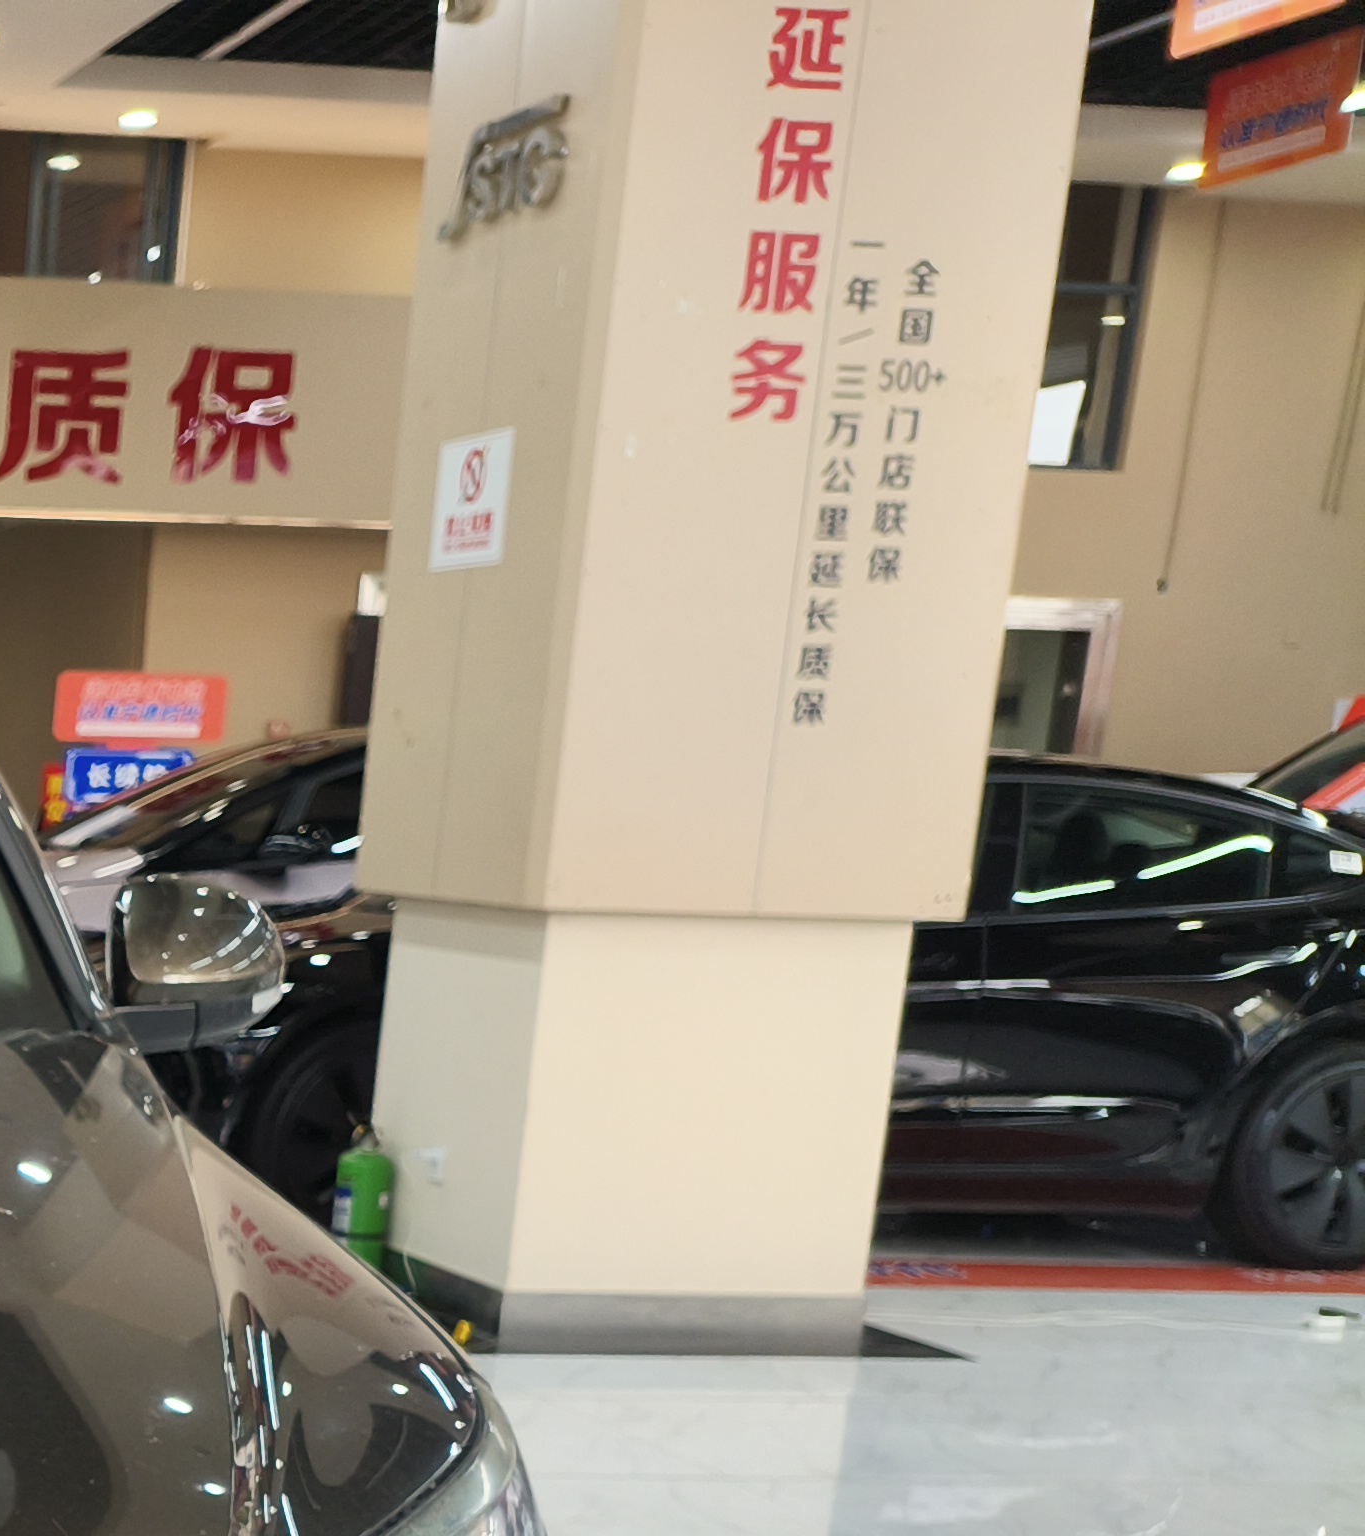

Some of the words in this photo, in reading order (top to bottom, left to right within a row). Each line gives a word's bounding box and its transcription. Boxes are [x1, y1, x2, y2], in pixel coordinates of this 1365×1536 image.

[728, 6, 851, 423] 延保服务
[866, 259, 948, 585] 全国500+门店联保
